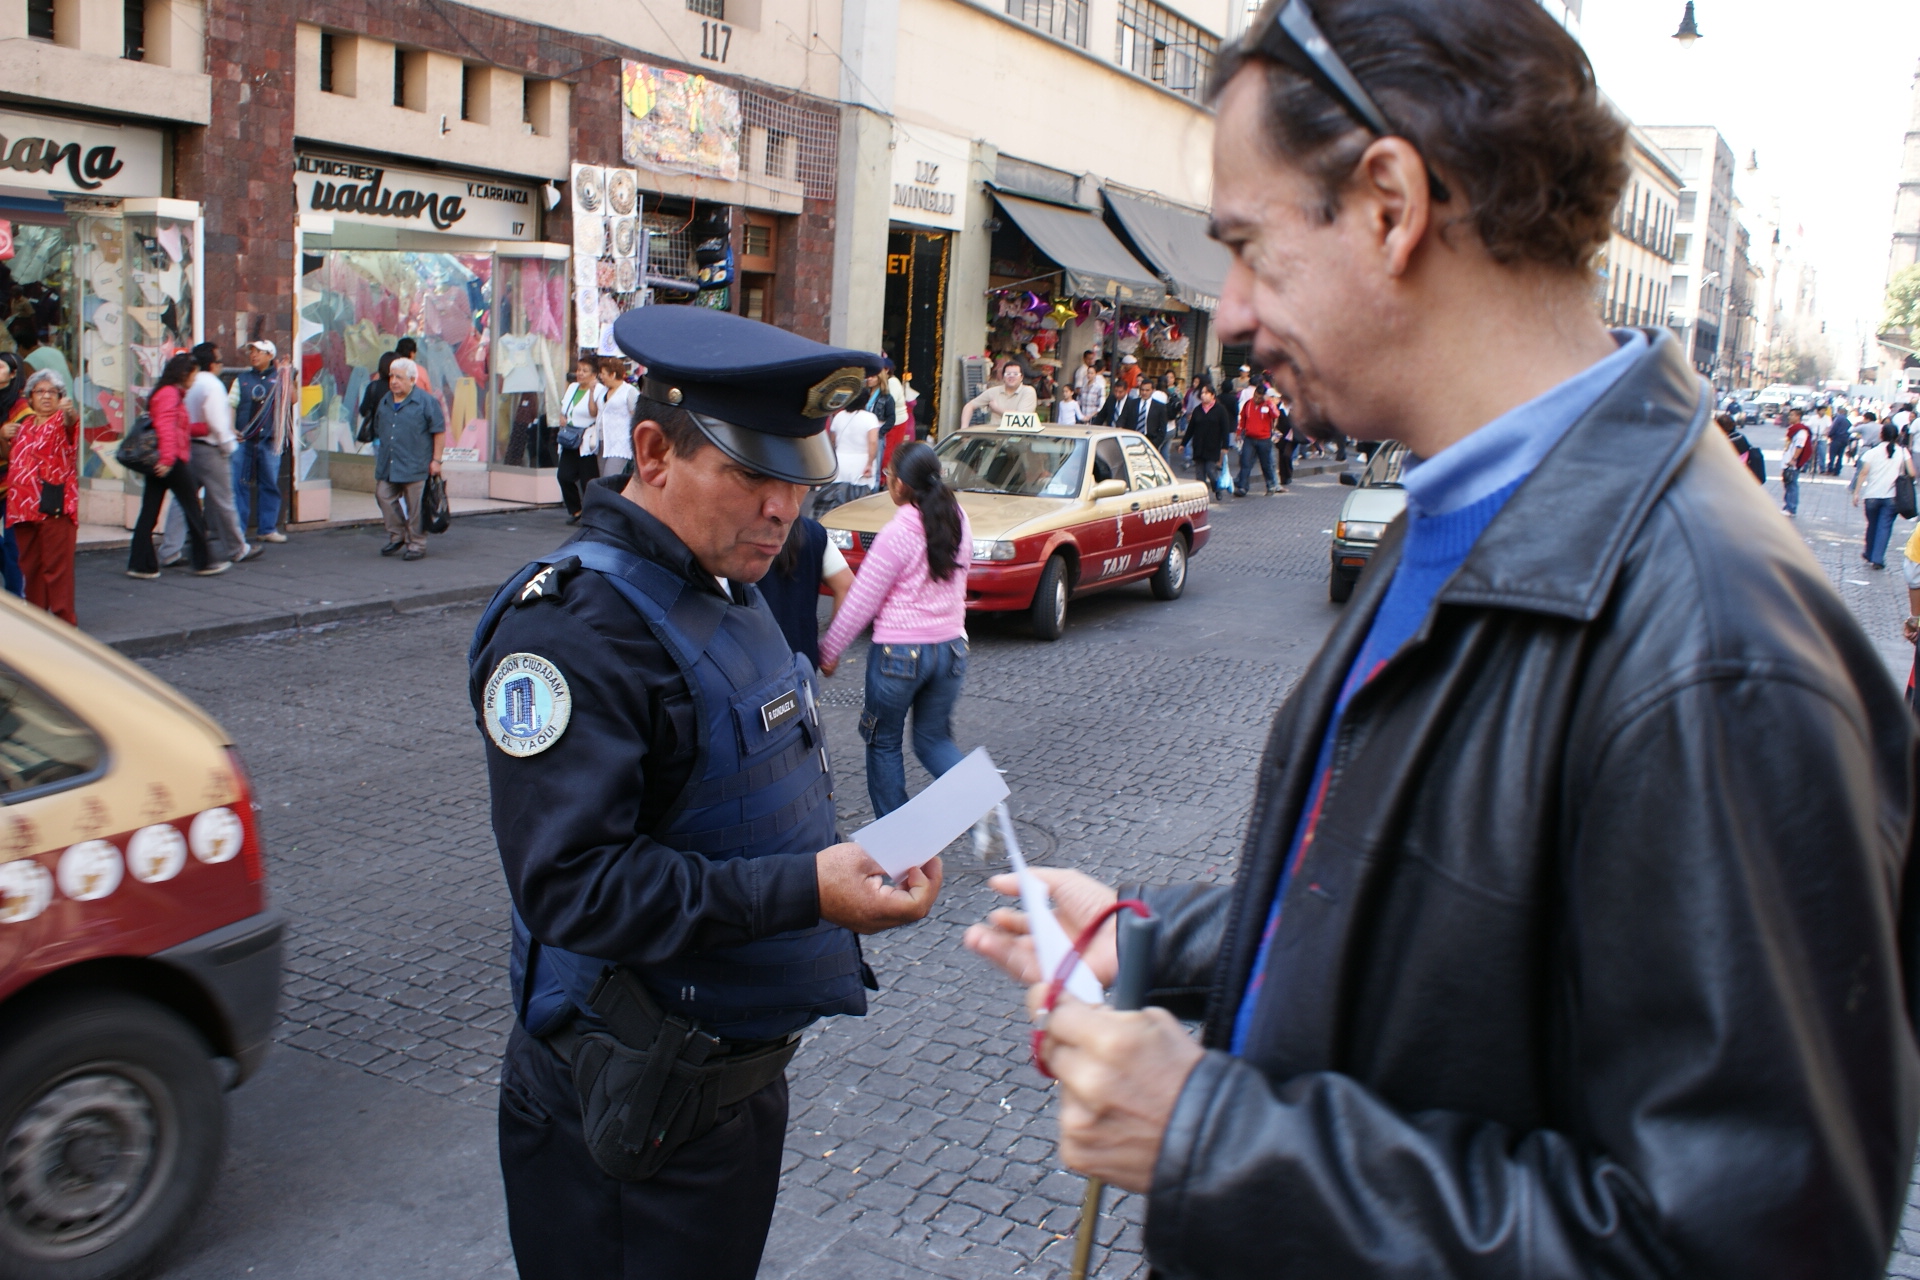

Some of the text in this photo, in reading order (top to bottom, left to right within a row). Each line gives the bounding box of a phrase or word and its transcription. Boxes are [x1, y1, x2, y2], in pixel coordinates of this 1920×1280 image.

[700, 20, 732, 64] 117
[299, 157, 376, 181] ALMACENES
[915, 160, 940, 185] LIZ
[294, 168, 466, 230] uadiana
[893, 183, 956, 215] MINELLI
[512, 221, 525, 236] 117
[1005, 414, 1034, 428] TAXI
[1101, 554, 1131, 576] TAXI
[522, 658, 565, 698] CIUDADANA
[501, 725, 558, 751] EL YAQUI
